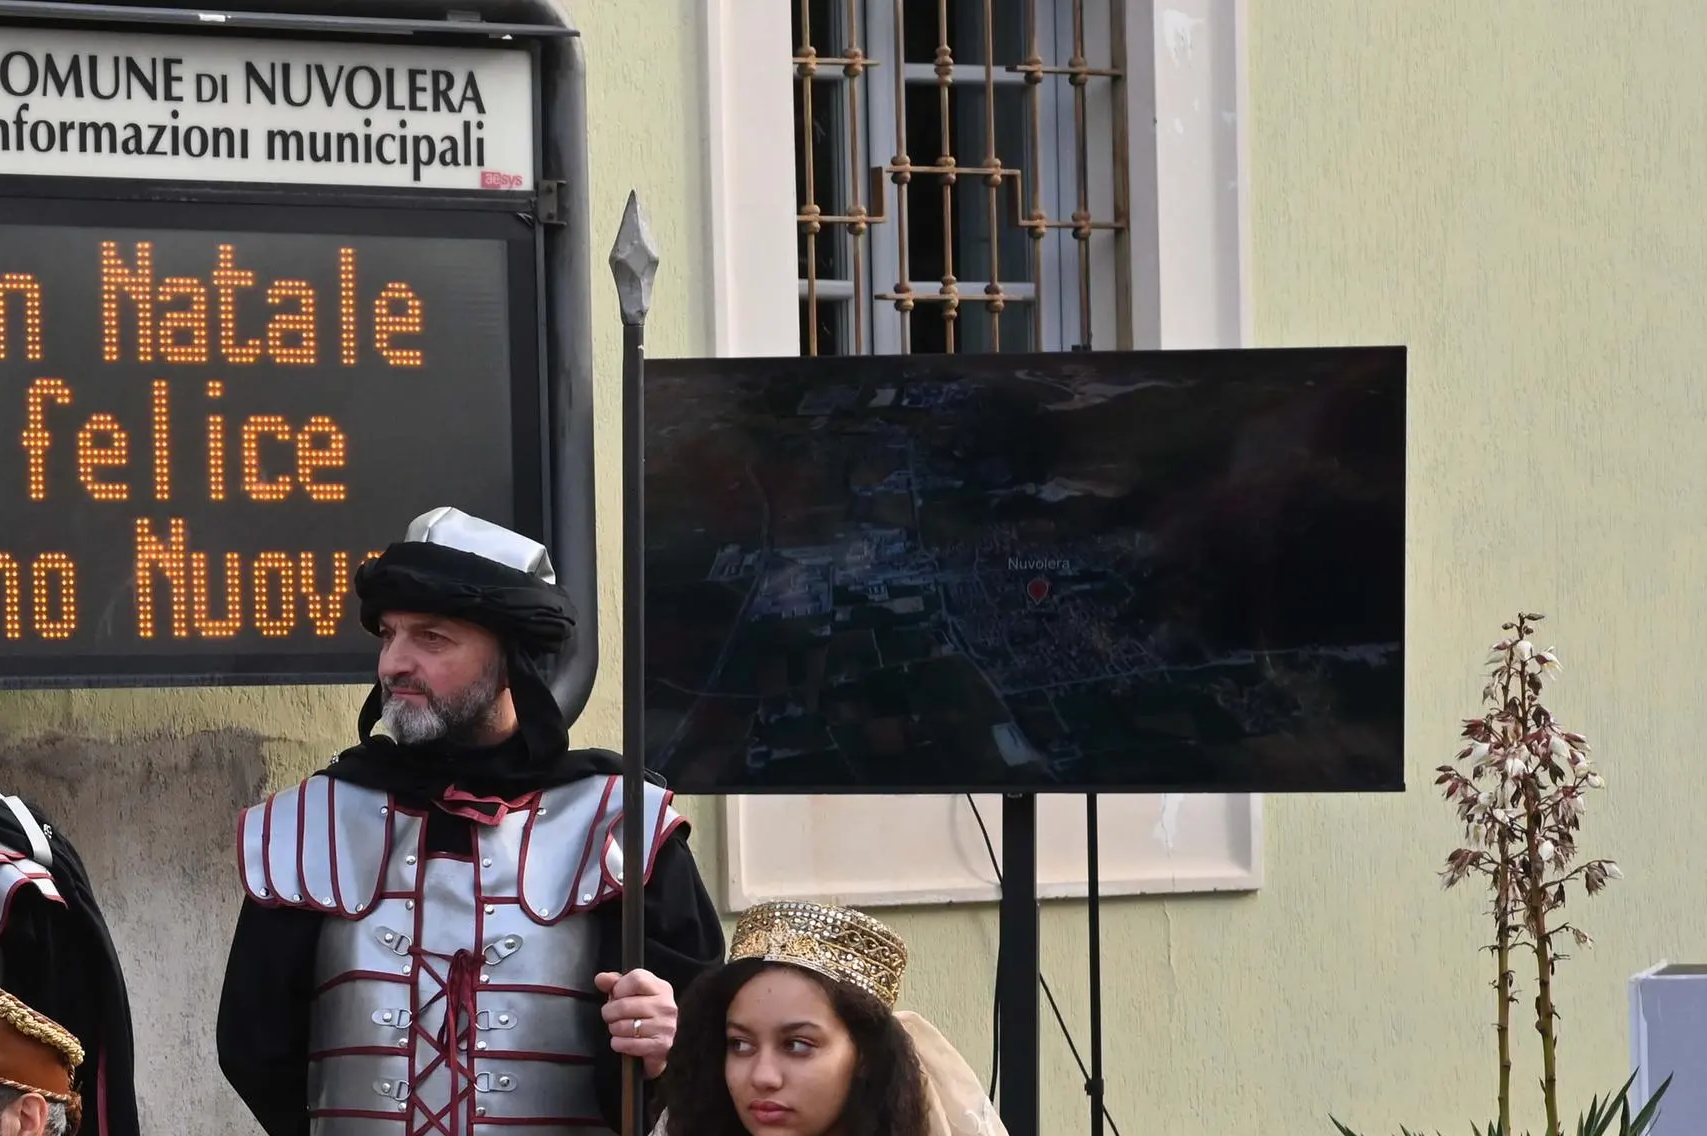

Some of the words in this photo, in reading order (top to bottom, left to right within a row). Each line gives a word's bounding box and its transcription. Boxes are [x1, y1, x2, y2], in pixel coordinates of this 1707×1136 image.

[195, 72, 229, 104] DI
[244, 60, 487, 115] NUVOLERA
[266, 117, 486, 182] municipali
[100, 240, 425, 367] Natale
[21, 376, 347, 501] felice
[133, 515, 382, 640] Nuov
[1007, 555, 1071, 571] Nuvolera
